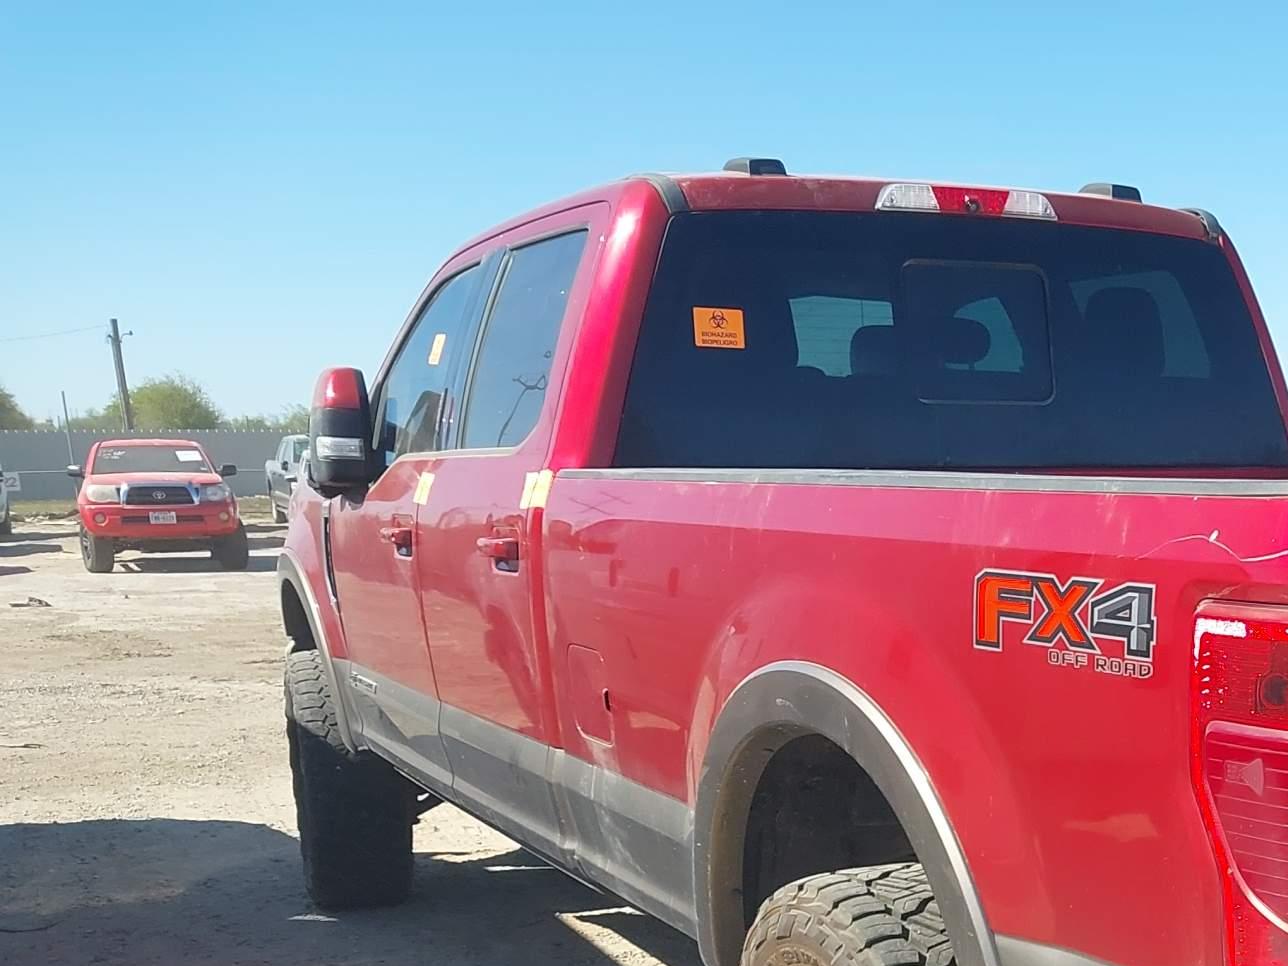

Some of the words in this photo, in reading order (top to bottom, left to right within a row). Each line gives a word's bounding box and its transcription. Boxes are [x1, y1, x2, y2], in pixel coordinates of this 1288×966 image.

[974, 568, 1156, 661] FX4
[1047, 648, 1088, 669] OFF
[1094, 656, 1153, 679] ROAD
